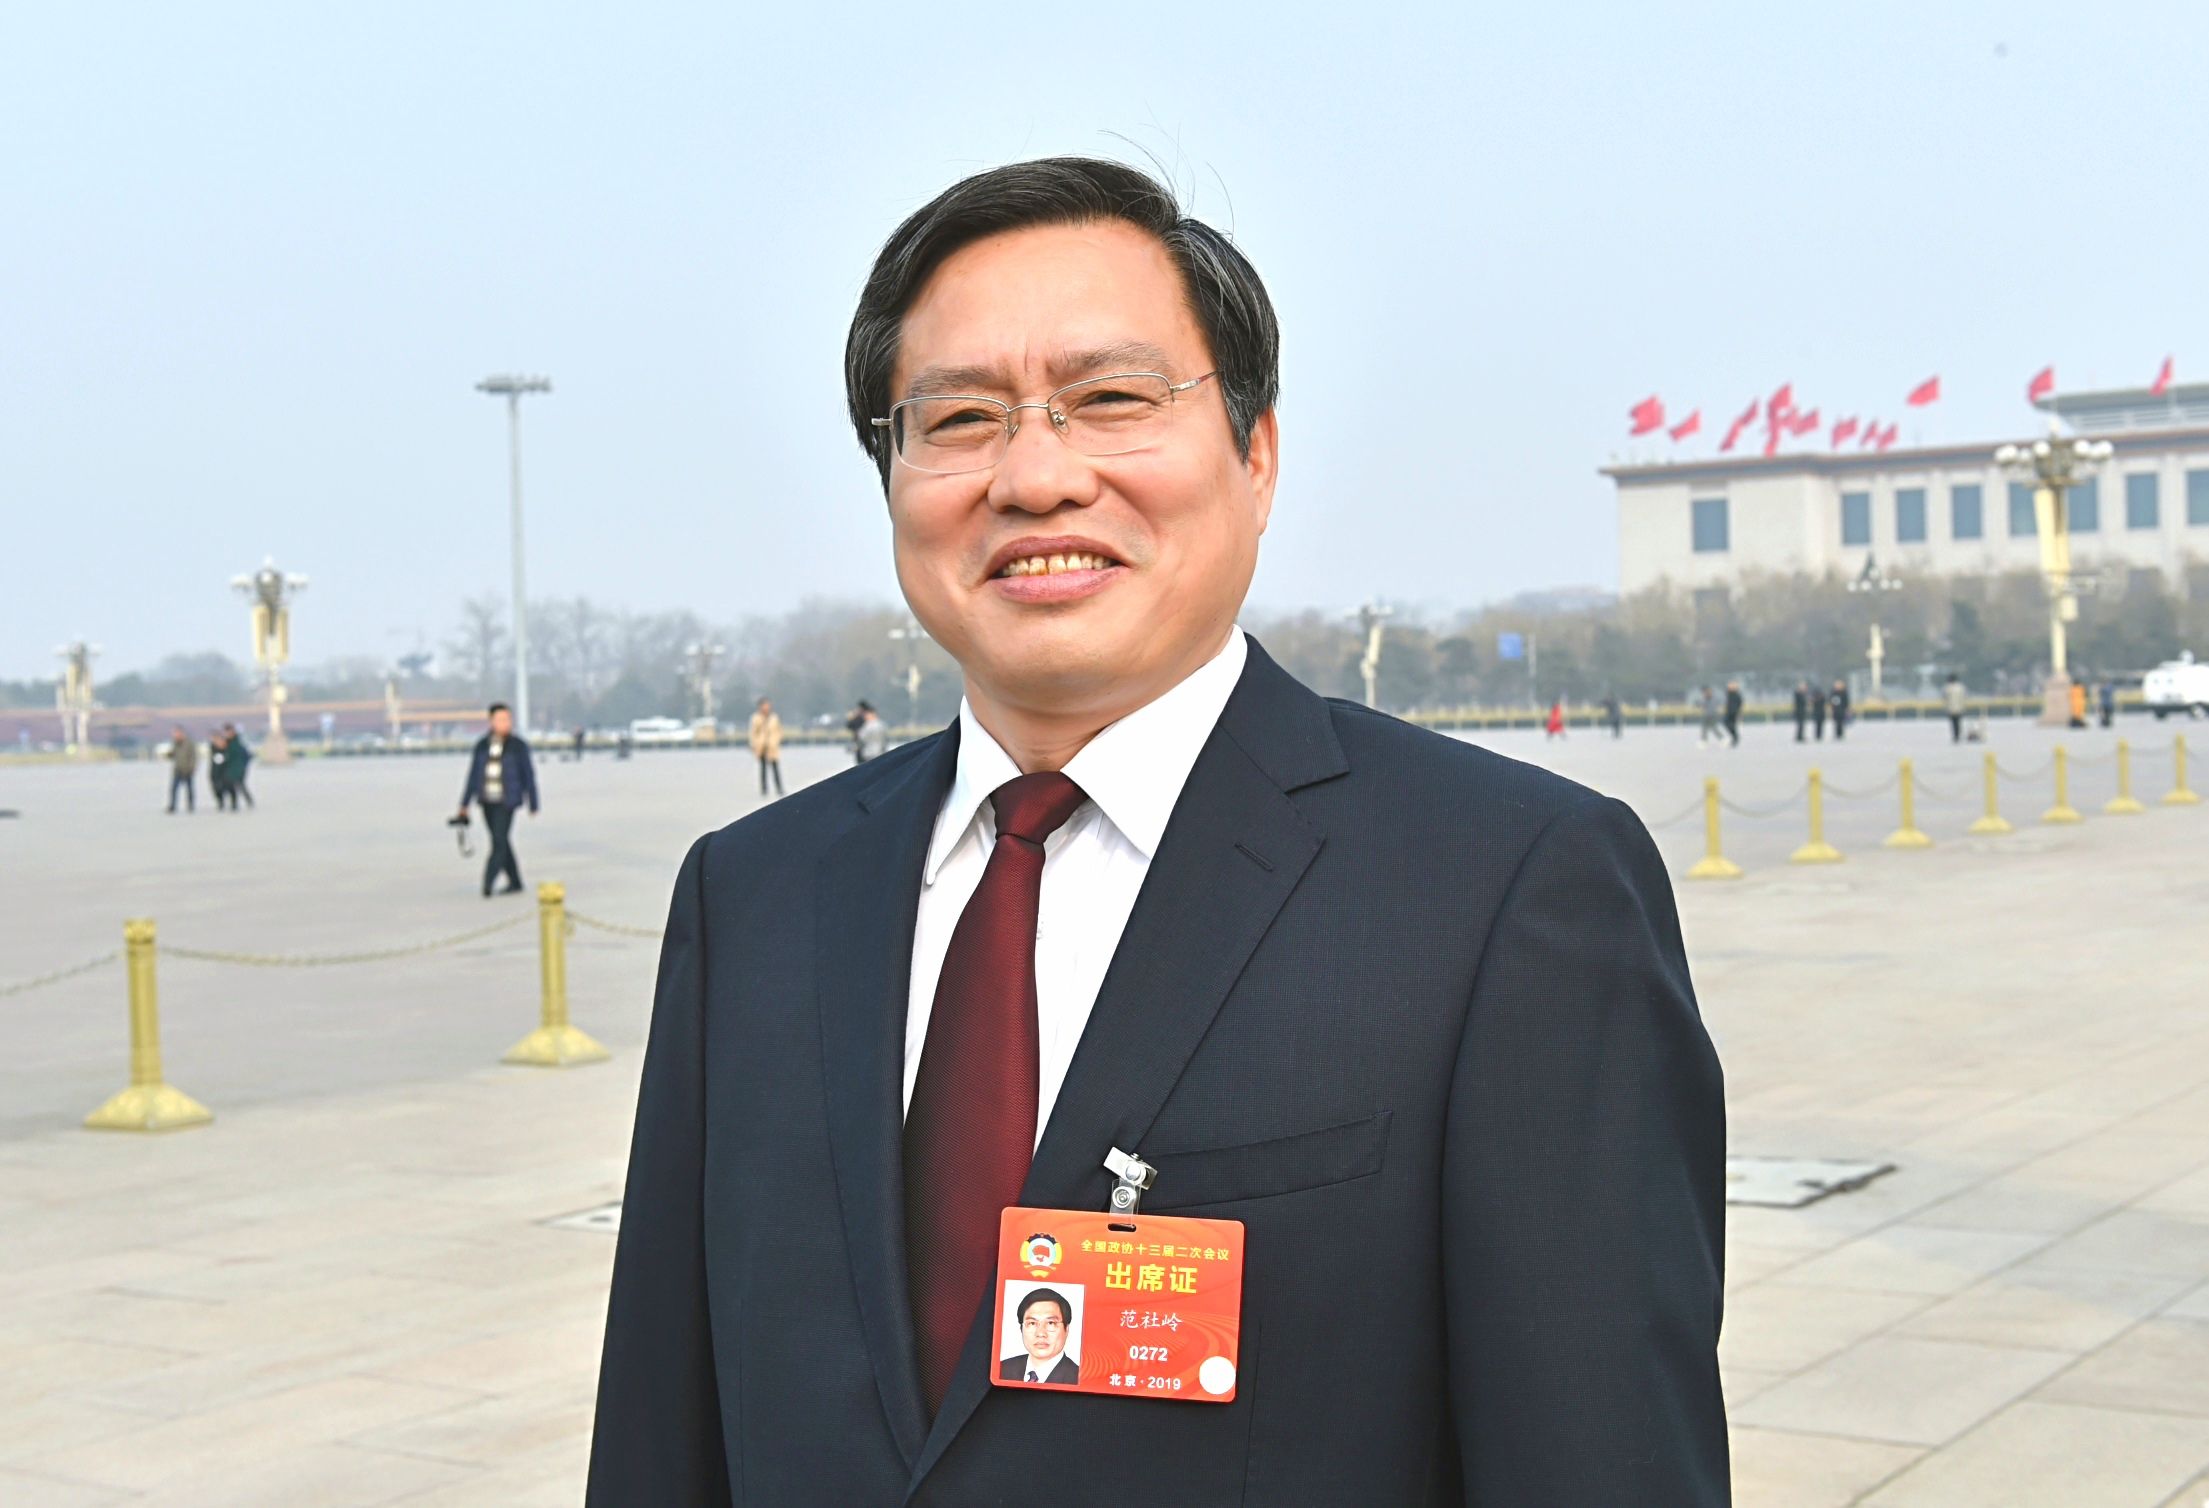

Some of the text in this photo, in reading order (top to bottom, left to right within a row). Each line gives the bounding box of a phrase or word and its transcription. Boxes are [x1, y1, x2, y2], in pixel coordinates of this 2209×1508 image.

[1081, 1240, 1229, 1260] 全国政协十三届二次会议
[1106, 1262, 1198, 1293] 出席证
[1120, 1310, 1183, 1331] 范社岭
[1129, 1346, 1168, 1361] 0272
